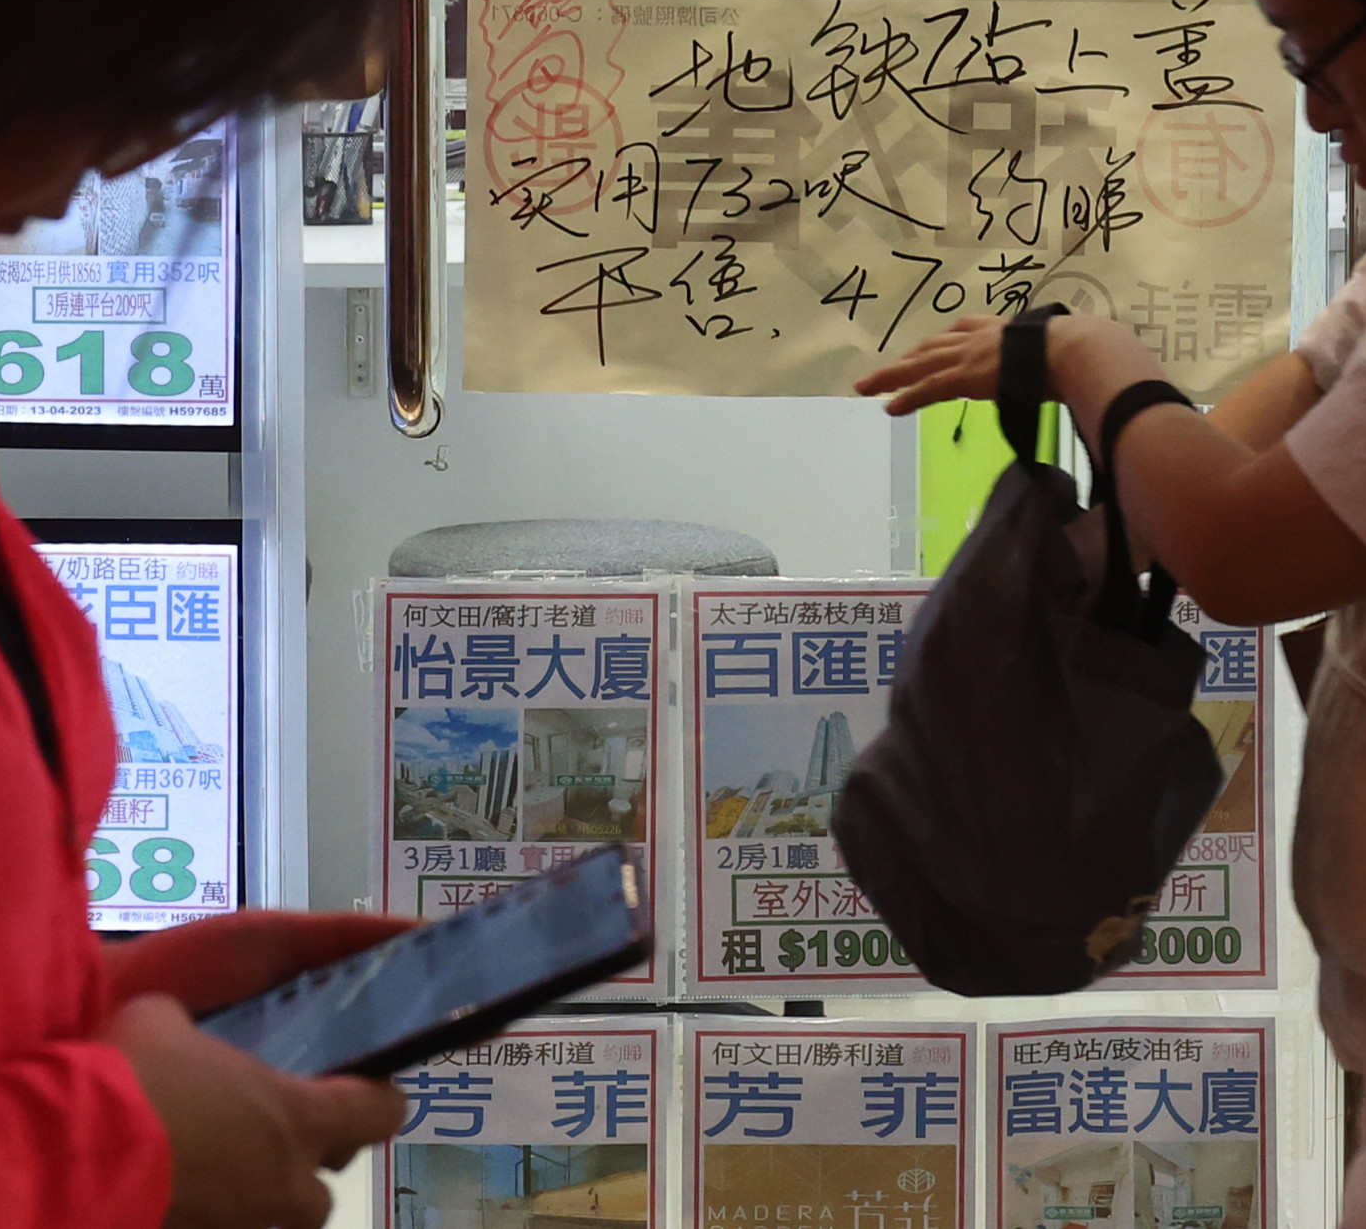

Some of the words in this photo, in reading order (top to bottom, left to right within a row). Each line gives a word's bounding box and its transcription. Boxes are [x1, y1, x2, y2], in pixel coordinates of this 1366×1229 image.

[394, 633, 651, 700] 怡景大廈
[1005, 1071, 1259, 1137] 富達大廈
[708, 1205, 834, 1220] MADERA
